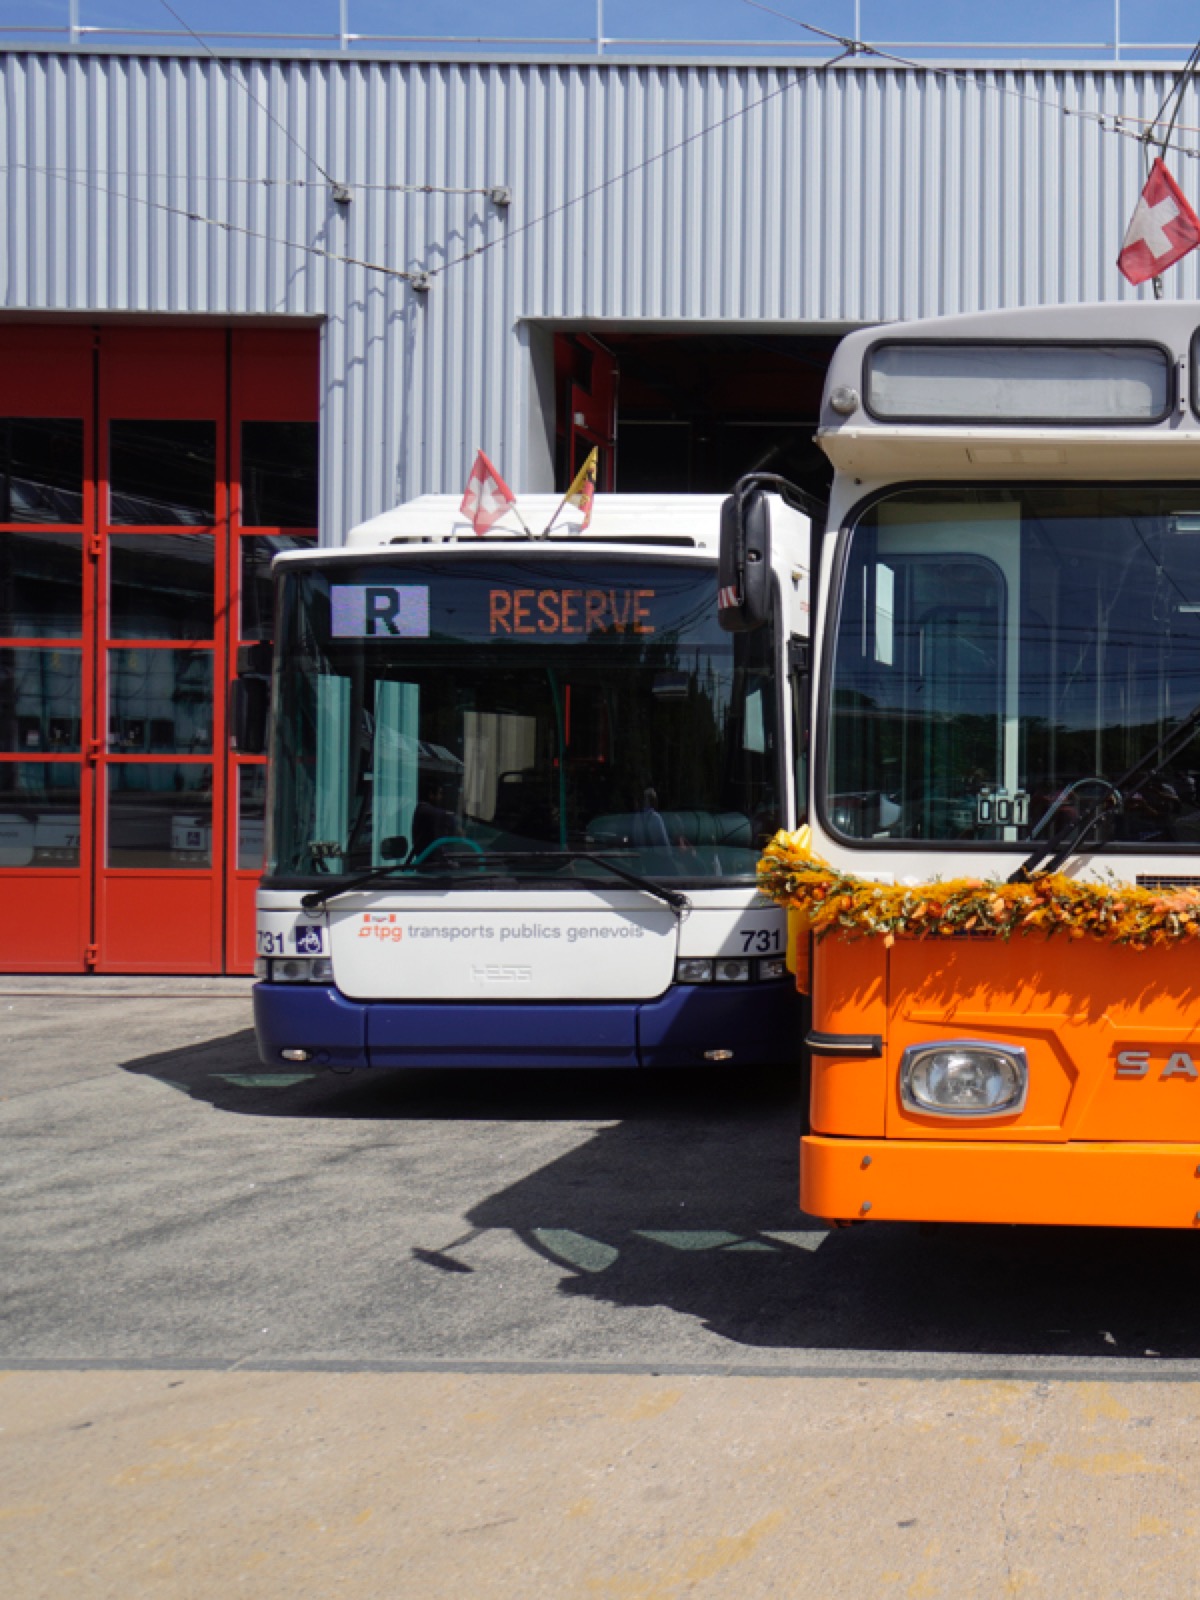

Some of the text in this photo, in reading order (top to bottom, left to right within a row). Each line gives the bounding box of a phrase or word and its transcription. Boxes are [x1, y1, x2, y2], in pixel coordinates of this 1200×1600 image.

[365, 587, 400, 635] R
[489, 589, 655, 634] RESERVE
[257, 930, 284, 954] 731
[407, 925, 495, 942] transports
[500, 924, 562, 942] publics
[566, 924, 645, 942] genevois
[740, 929, 781, 952] 731
